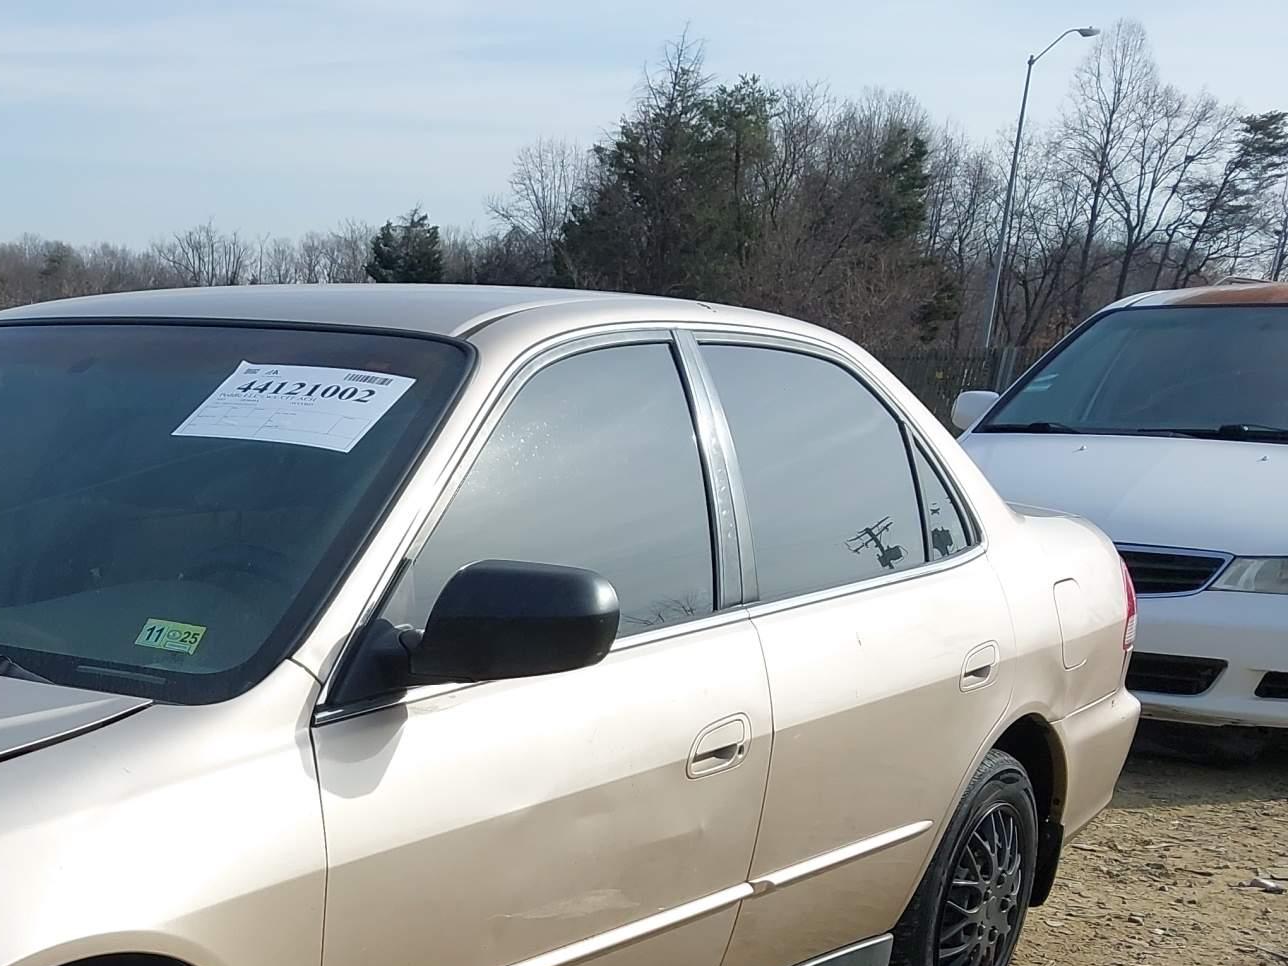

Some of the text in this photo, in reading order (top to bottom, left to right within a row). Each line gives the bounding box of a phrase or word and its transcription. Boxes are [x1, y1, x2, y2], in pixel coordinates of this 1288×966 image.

[237, 379, 376, 403] 44121002
[145, 625, 200, 645] 11 25
